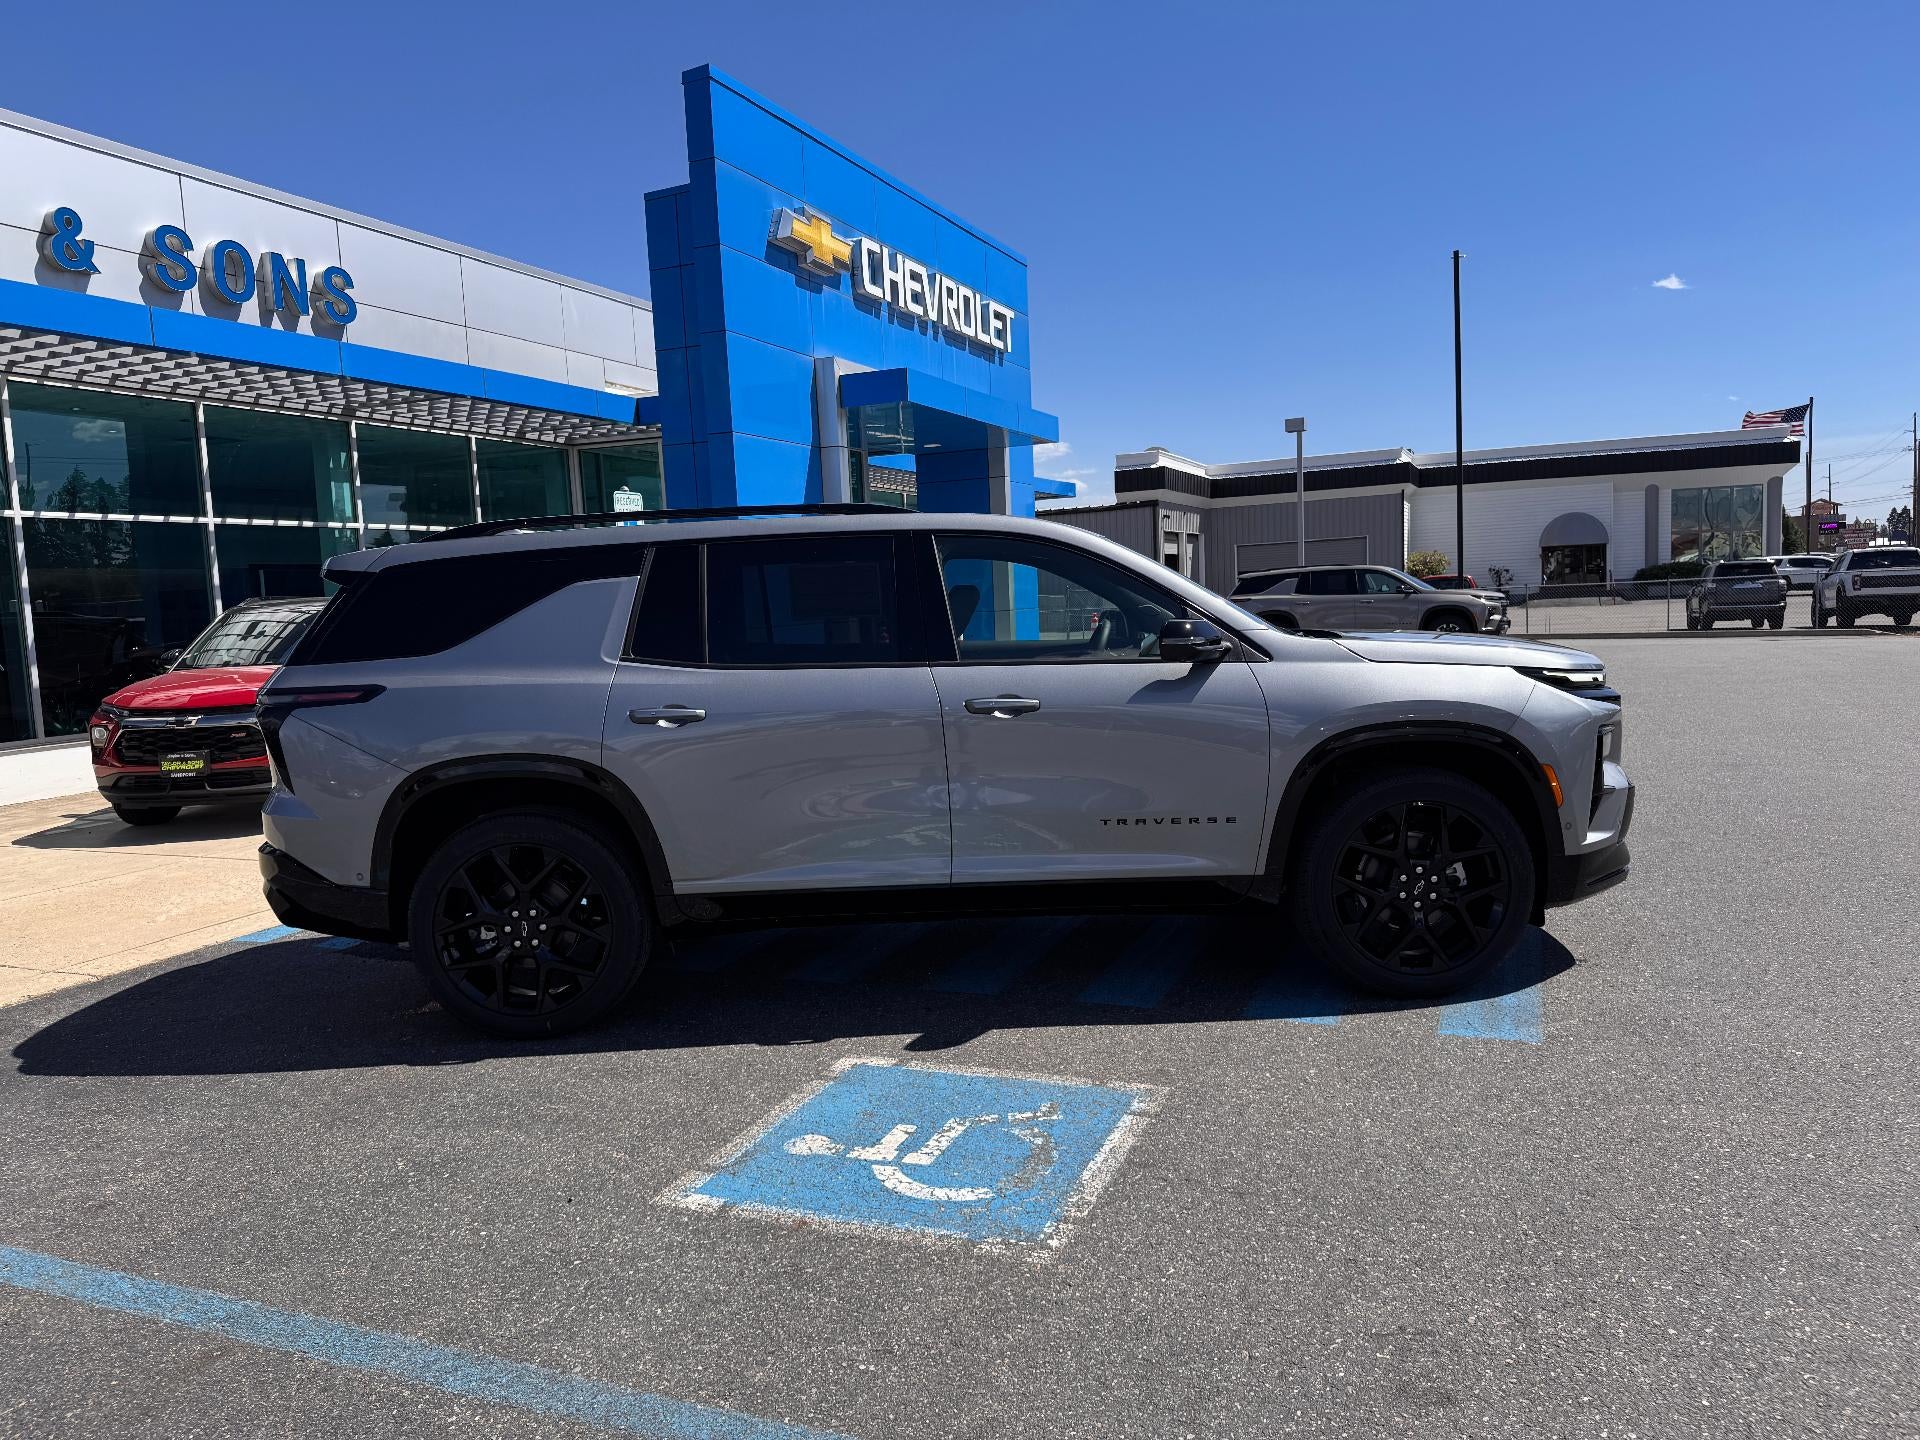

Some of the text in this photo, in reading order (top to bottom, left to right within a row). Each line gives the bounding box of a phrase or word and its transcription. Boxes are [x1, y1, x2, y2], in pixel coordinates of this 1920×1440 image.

[48, 206, 358, 326] & SONS
[858, 237, 1015, 353] CHEVROLET
[1099, 816, 1238, 826] TRAVERSE
